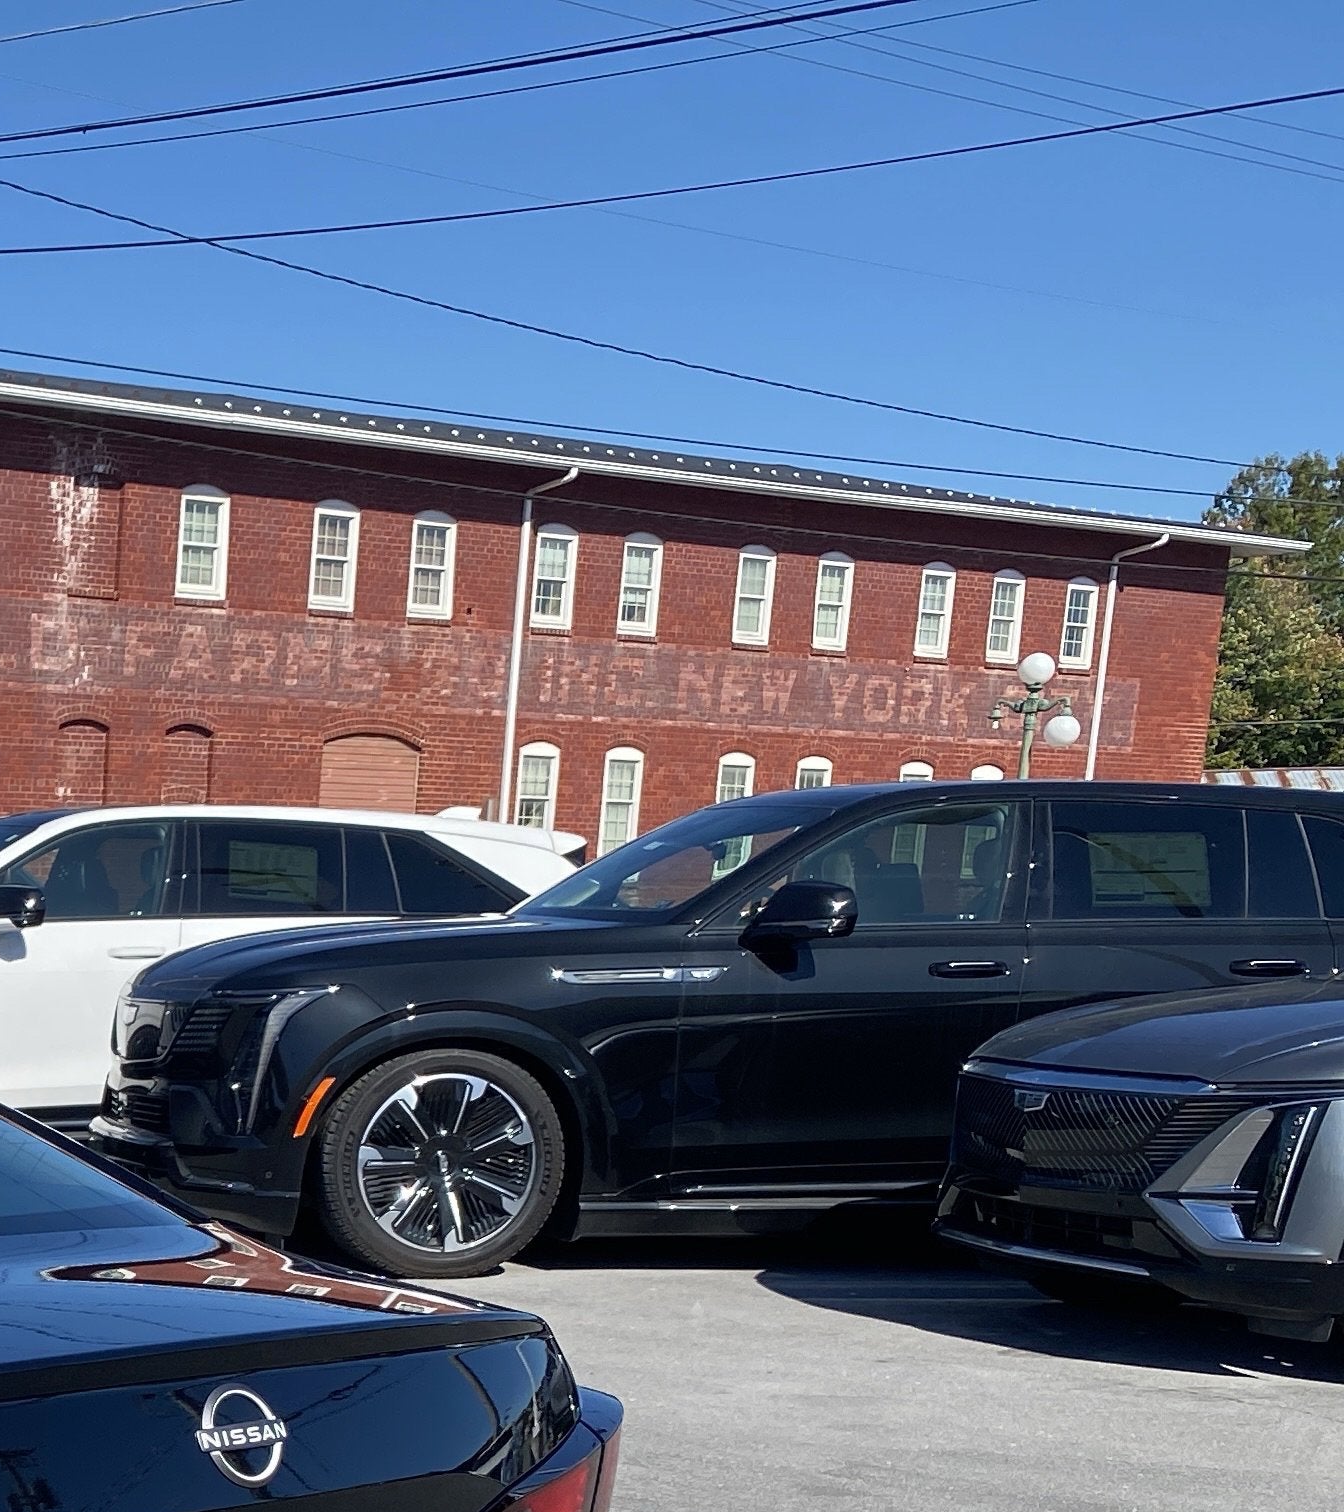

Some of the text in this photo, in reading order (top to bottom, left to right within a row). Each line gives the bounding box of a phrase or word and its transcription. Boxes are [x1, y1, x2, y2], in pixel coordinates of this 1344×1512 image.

[122, 621, 390, 692] FARMS
[677, 663, 797, 715] NEW
[828, 672, 976, 727] YORK
[200, 1421, 287, 1449] NISSAN
